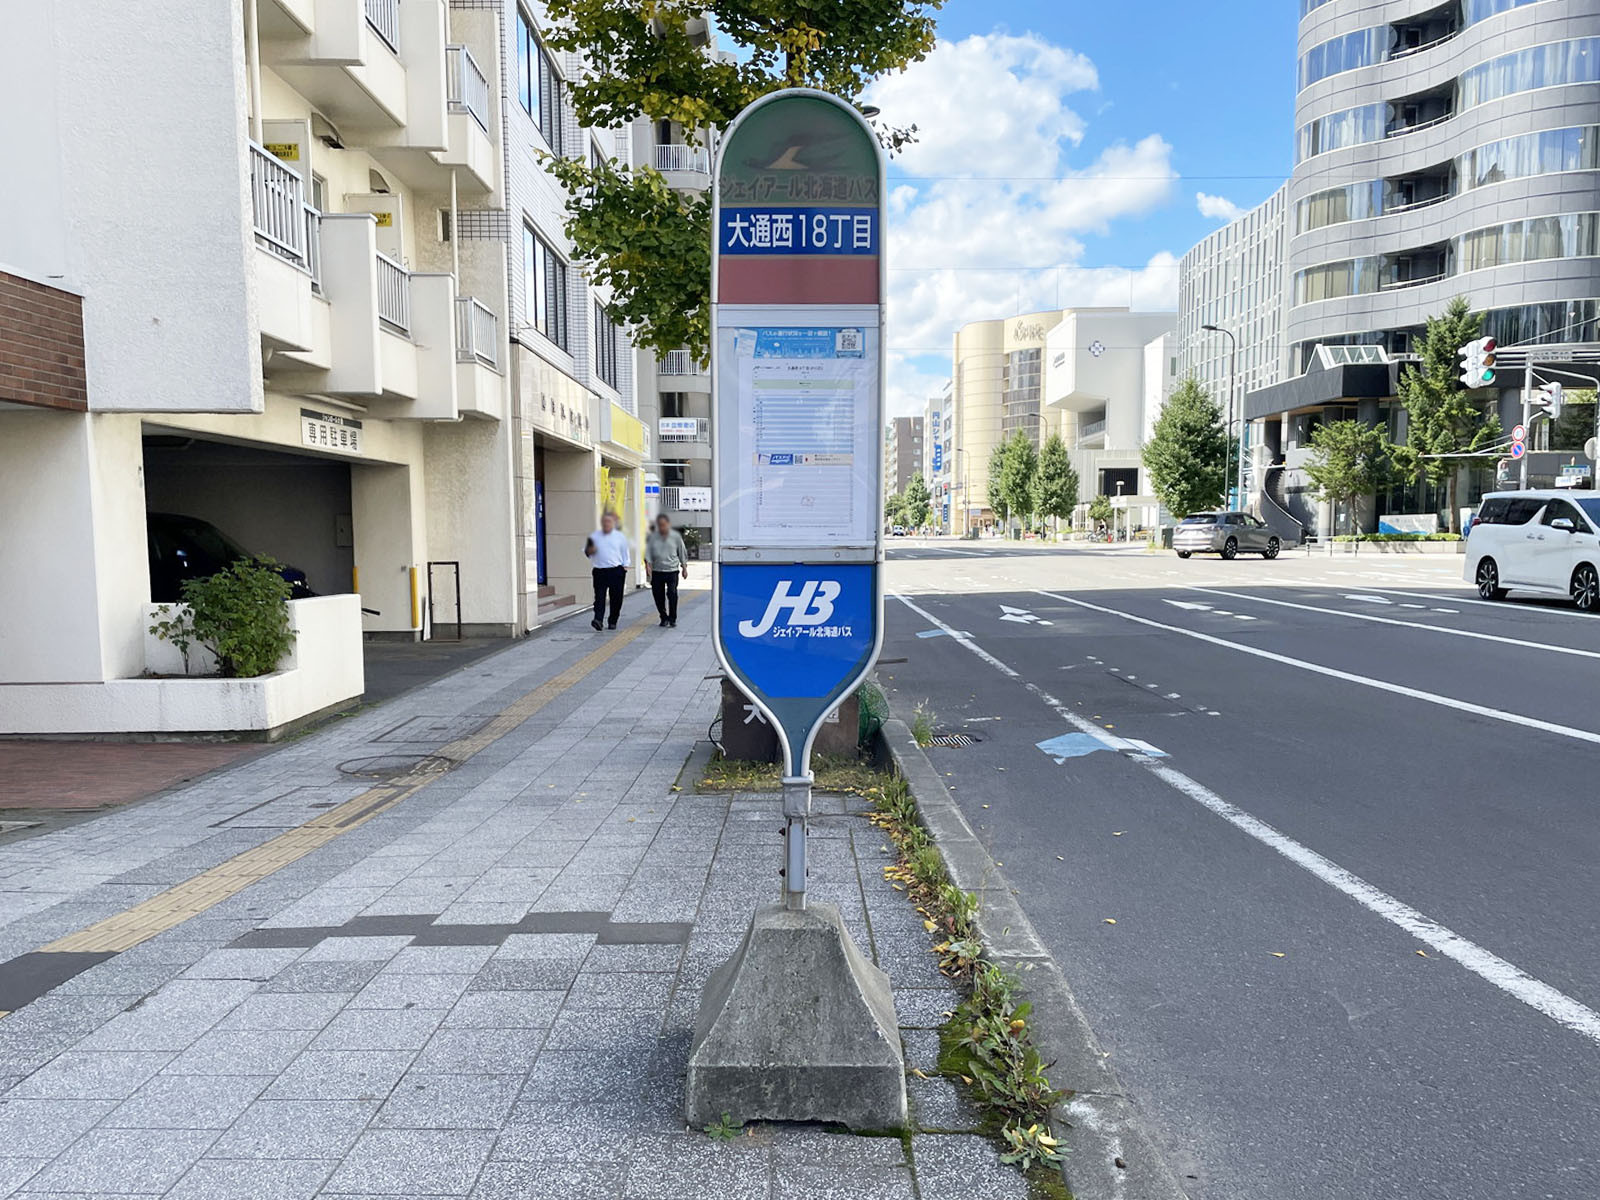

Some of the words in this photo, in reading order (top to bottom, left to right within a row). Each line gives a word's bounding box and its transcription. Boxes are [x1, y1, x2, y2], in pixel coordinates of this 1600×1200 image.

[727, 213, 872, 249] 大通西18丁目
[308, 422, 358, 451] 専用駐車場
[773, 626, 853, 638] ジェイ・アール北海道バス
